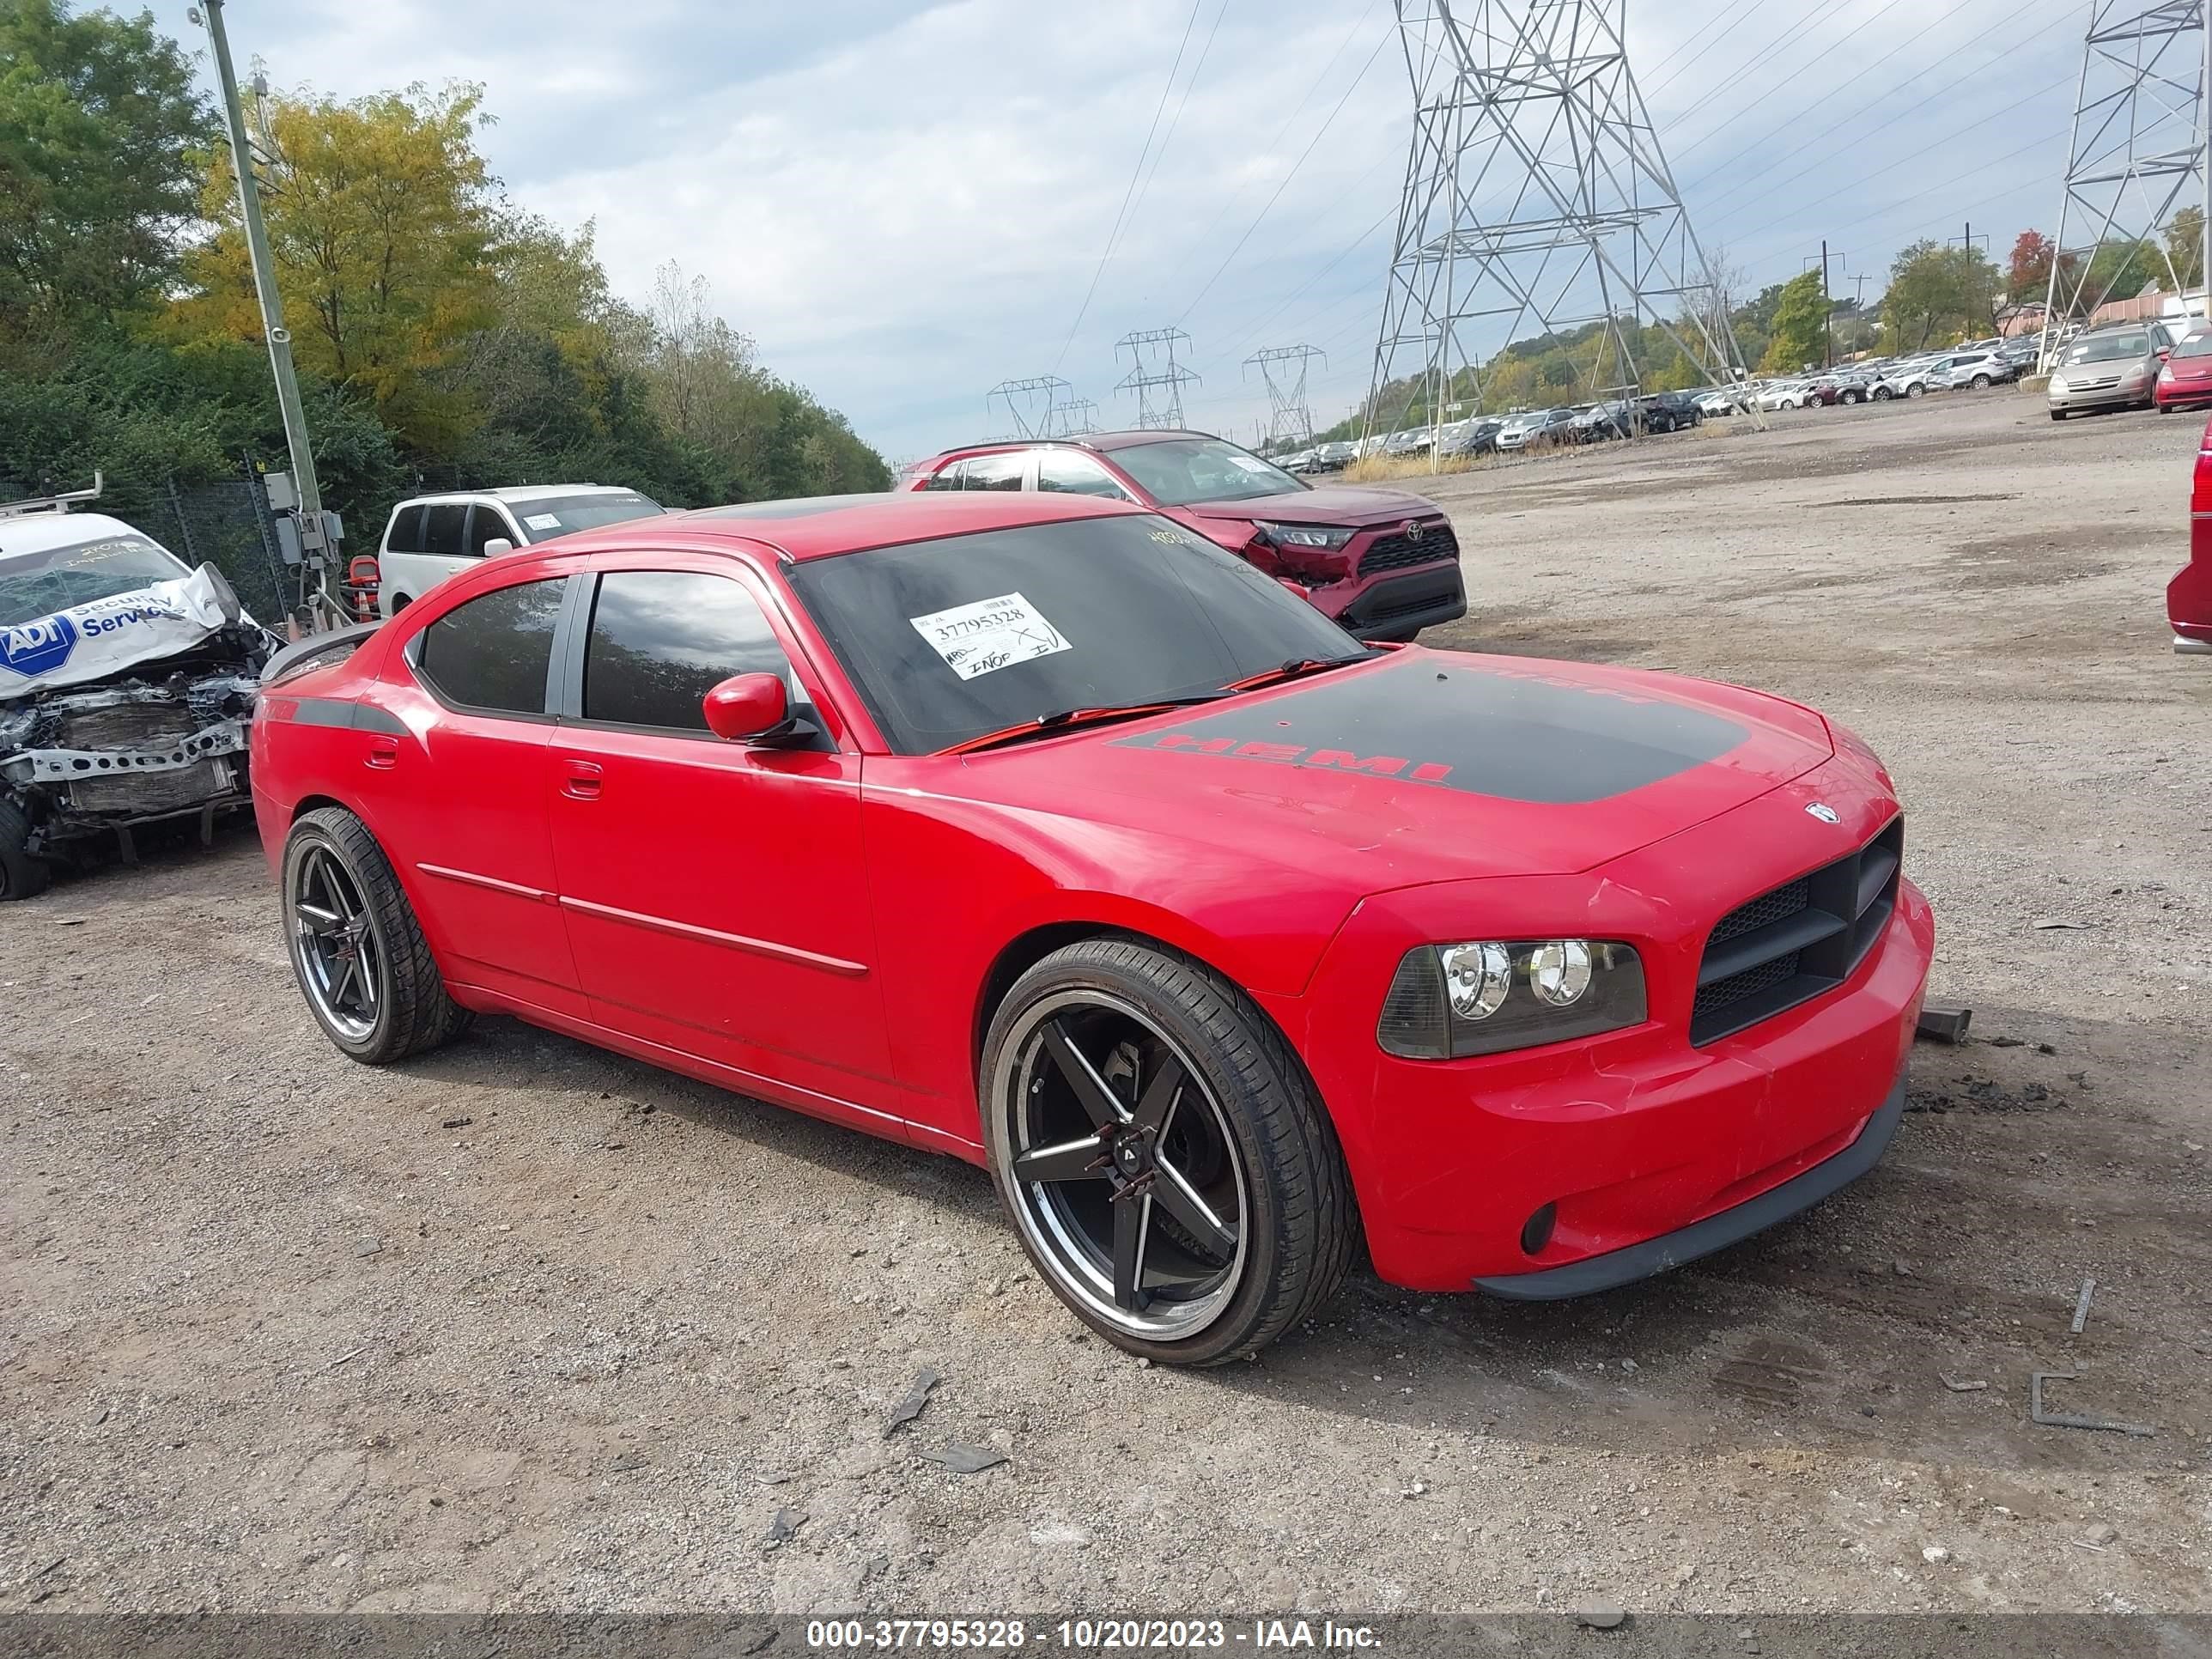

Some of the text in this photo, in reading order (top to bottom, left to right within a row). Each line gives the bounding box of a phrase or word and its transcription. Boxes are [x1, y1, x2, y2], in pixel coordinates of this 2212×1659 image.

[71, 596, 171, 616] Security
[9, 617, 59, 656] ADT
[935, 609, 1024, 640] 37795328
[1154, 733, 1453, 781] HEMI
